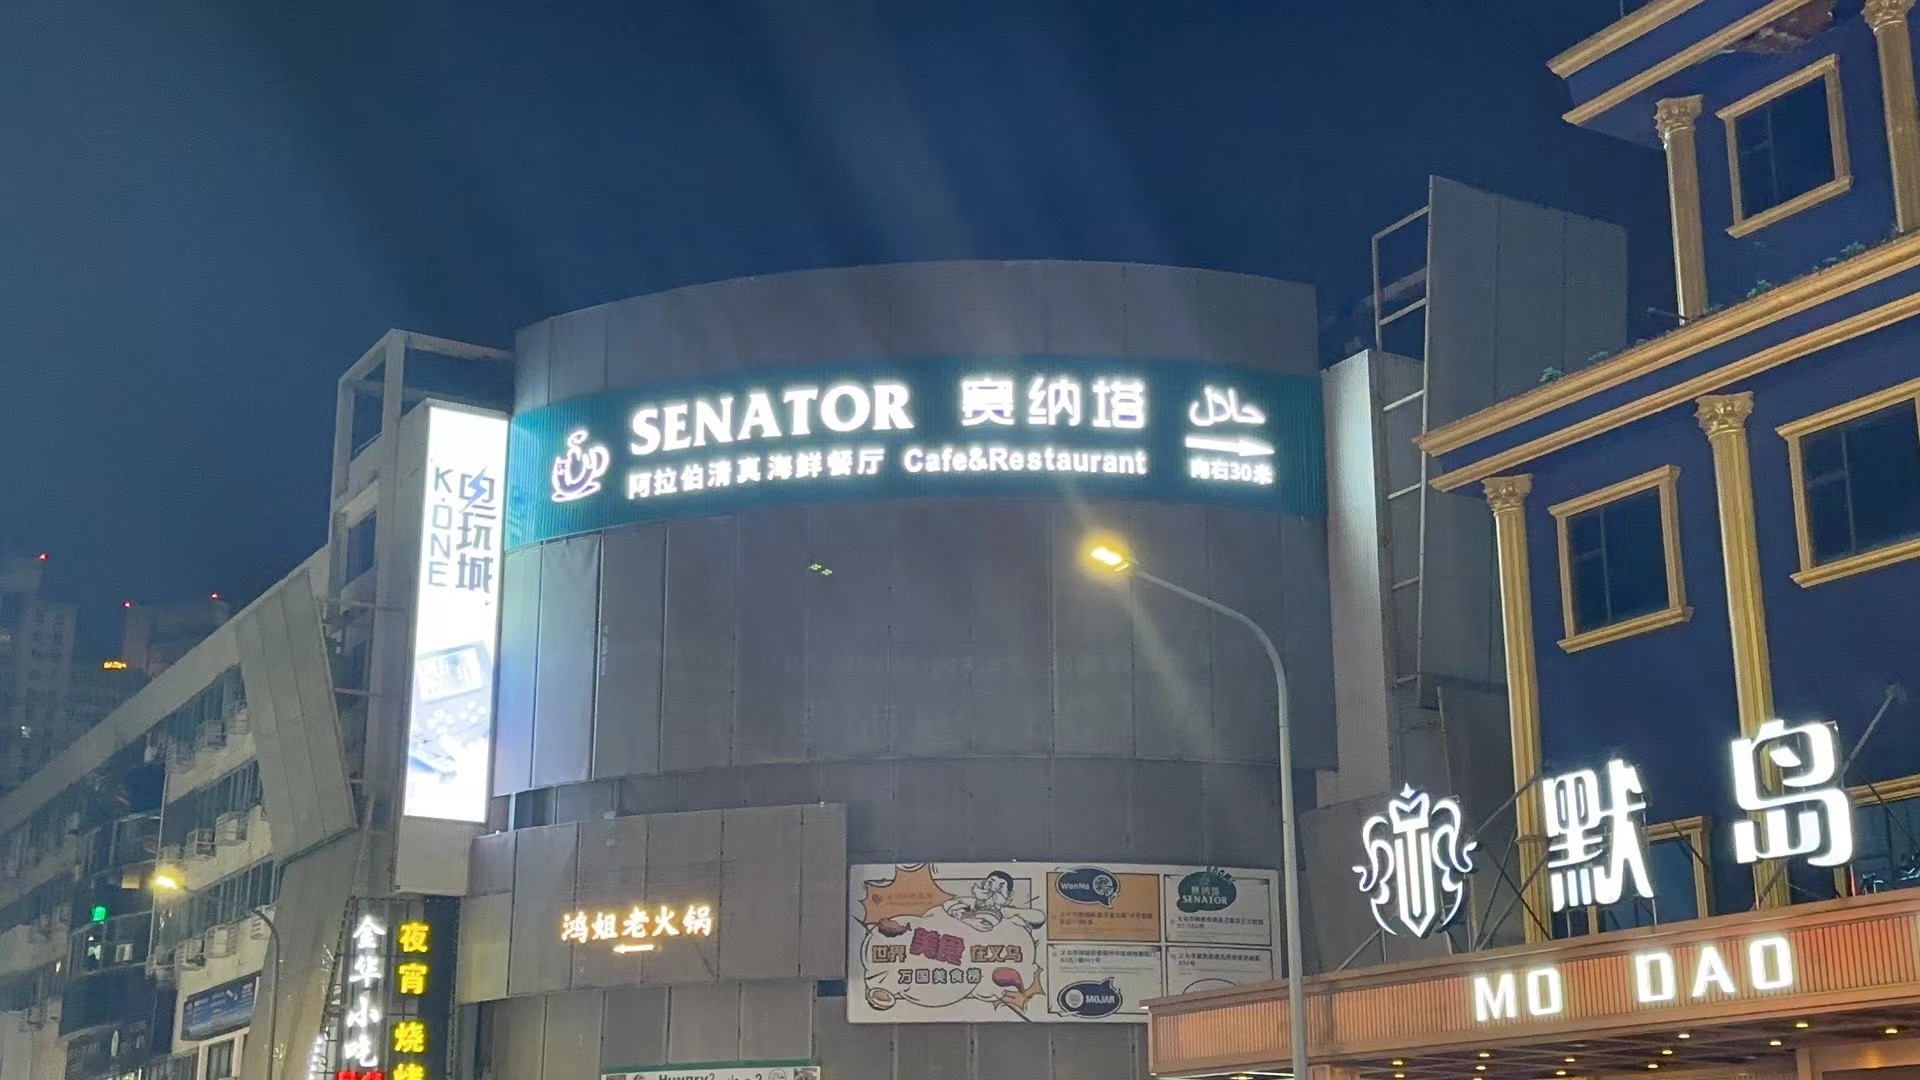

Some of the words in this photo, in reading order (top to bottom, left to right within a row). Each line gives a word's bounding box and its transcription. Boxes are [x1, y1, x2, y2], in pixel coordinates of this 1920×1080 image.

[630, 383, 915, 456] SENATOR
[961, 374, 1146, 430] 赛纳塔
[1189, 385, 1266, 427] حلال
[627, 448, 886, 501] 阿拉伯清真海鲜餐厅
[904, 447, 1148, 476] Cafe&Restaurant
[1543, 719, 1855, 913] 默岛
[560, 903, 714, 944] 鸿姐老火锅
[1182, 894, 1228, 905] SENATOR
[344, 914, 387, 1069] 金华小吃
[1474, 966, 1563, 1023] MO
[1636, 935, 1795, 1005] DAO
